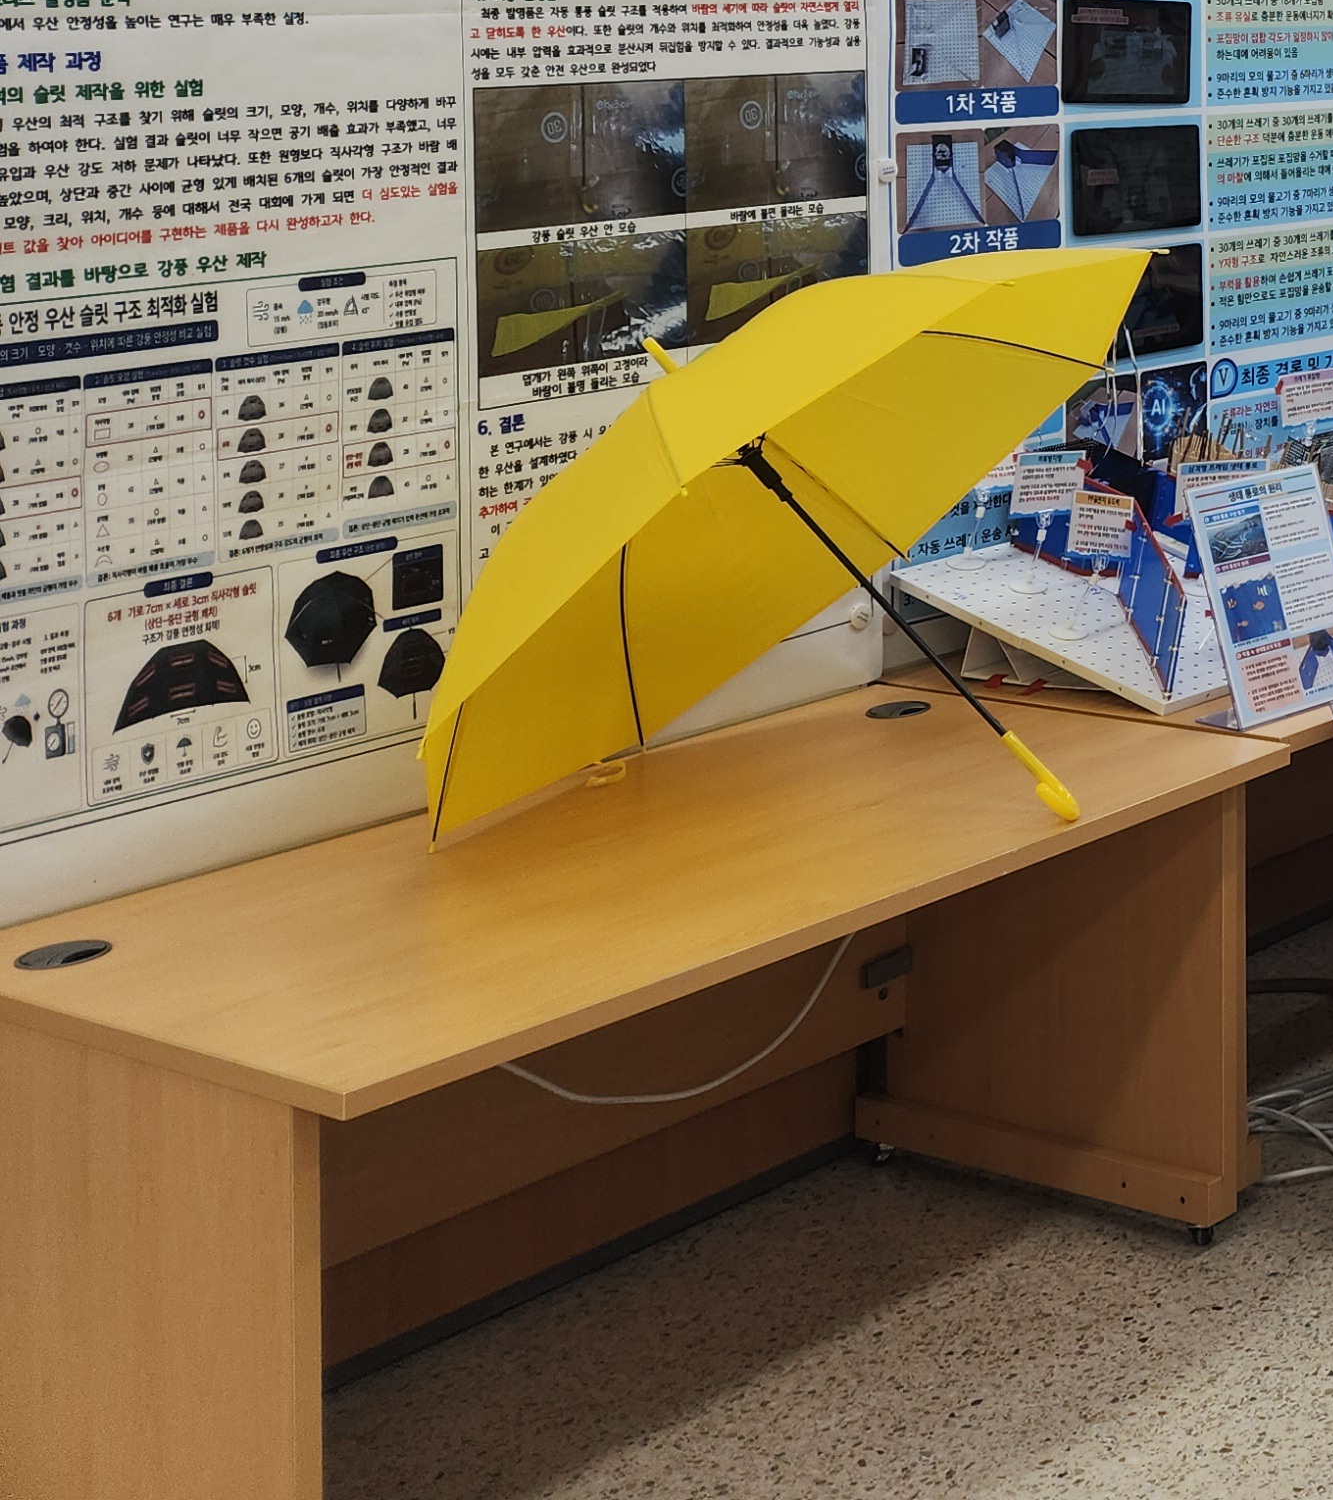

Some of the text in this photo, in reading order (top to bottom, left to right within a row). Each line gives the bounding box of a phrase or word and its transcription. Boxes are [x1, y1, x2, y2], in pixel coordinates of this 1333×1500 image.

[945, 94, 1018, 117] 1차 작품
[531, 221, 637, 243] 강풍 슬릿 우산 안 모습
[949, 230, 1019, 255] 2차 작품
[25, 250, 268, 292] 결과를 바탕으로 강풍 우산 제작
[8, 289, 218, 336] 안정 우산 슬릿 구조 최적화 실험
[1241, 366, 1270, 387] 최종
[1150, 397, 1167, 416] AI
[477, 412, 526, 437] 6. 결론
[1228, 481, 1283, 503] 생태 통로의 원리
